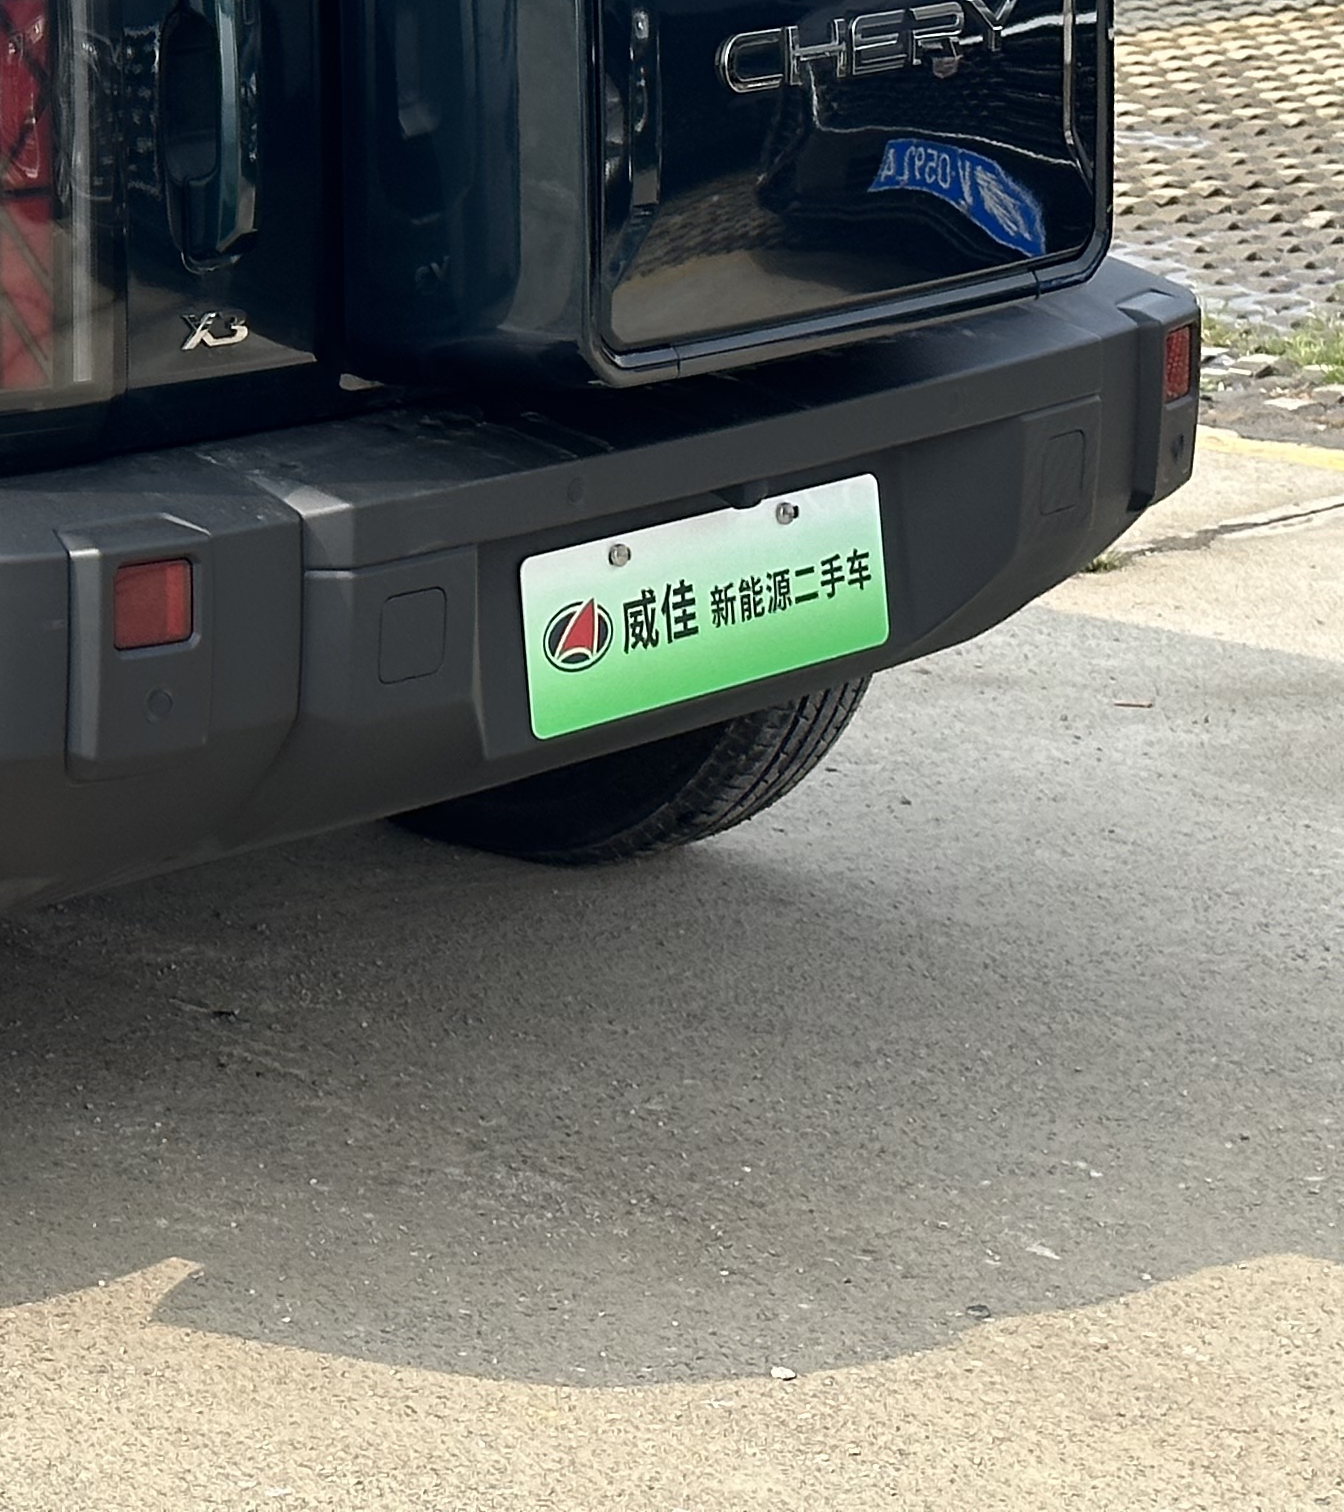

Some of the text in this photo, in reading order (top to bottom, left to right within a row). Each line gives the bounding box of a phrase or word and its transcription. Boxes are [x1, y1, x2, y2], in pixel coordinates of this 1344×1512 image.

[622, 548, 873, 655] 威佳 新能源二手车
